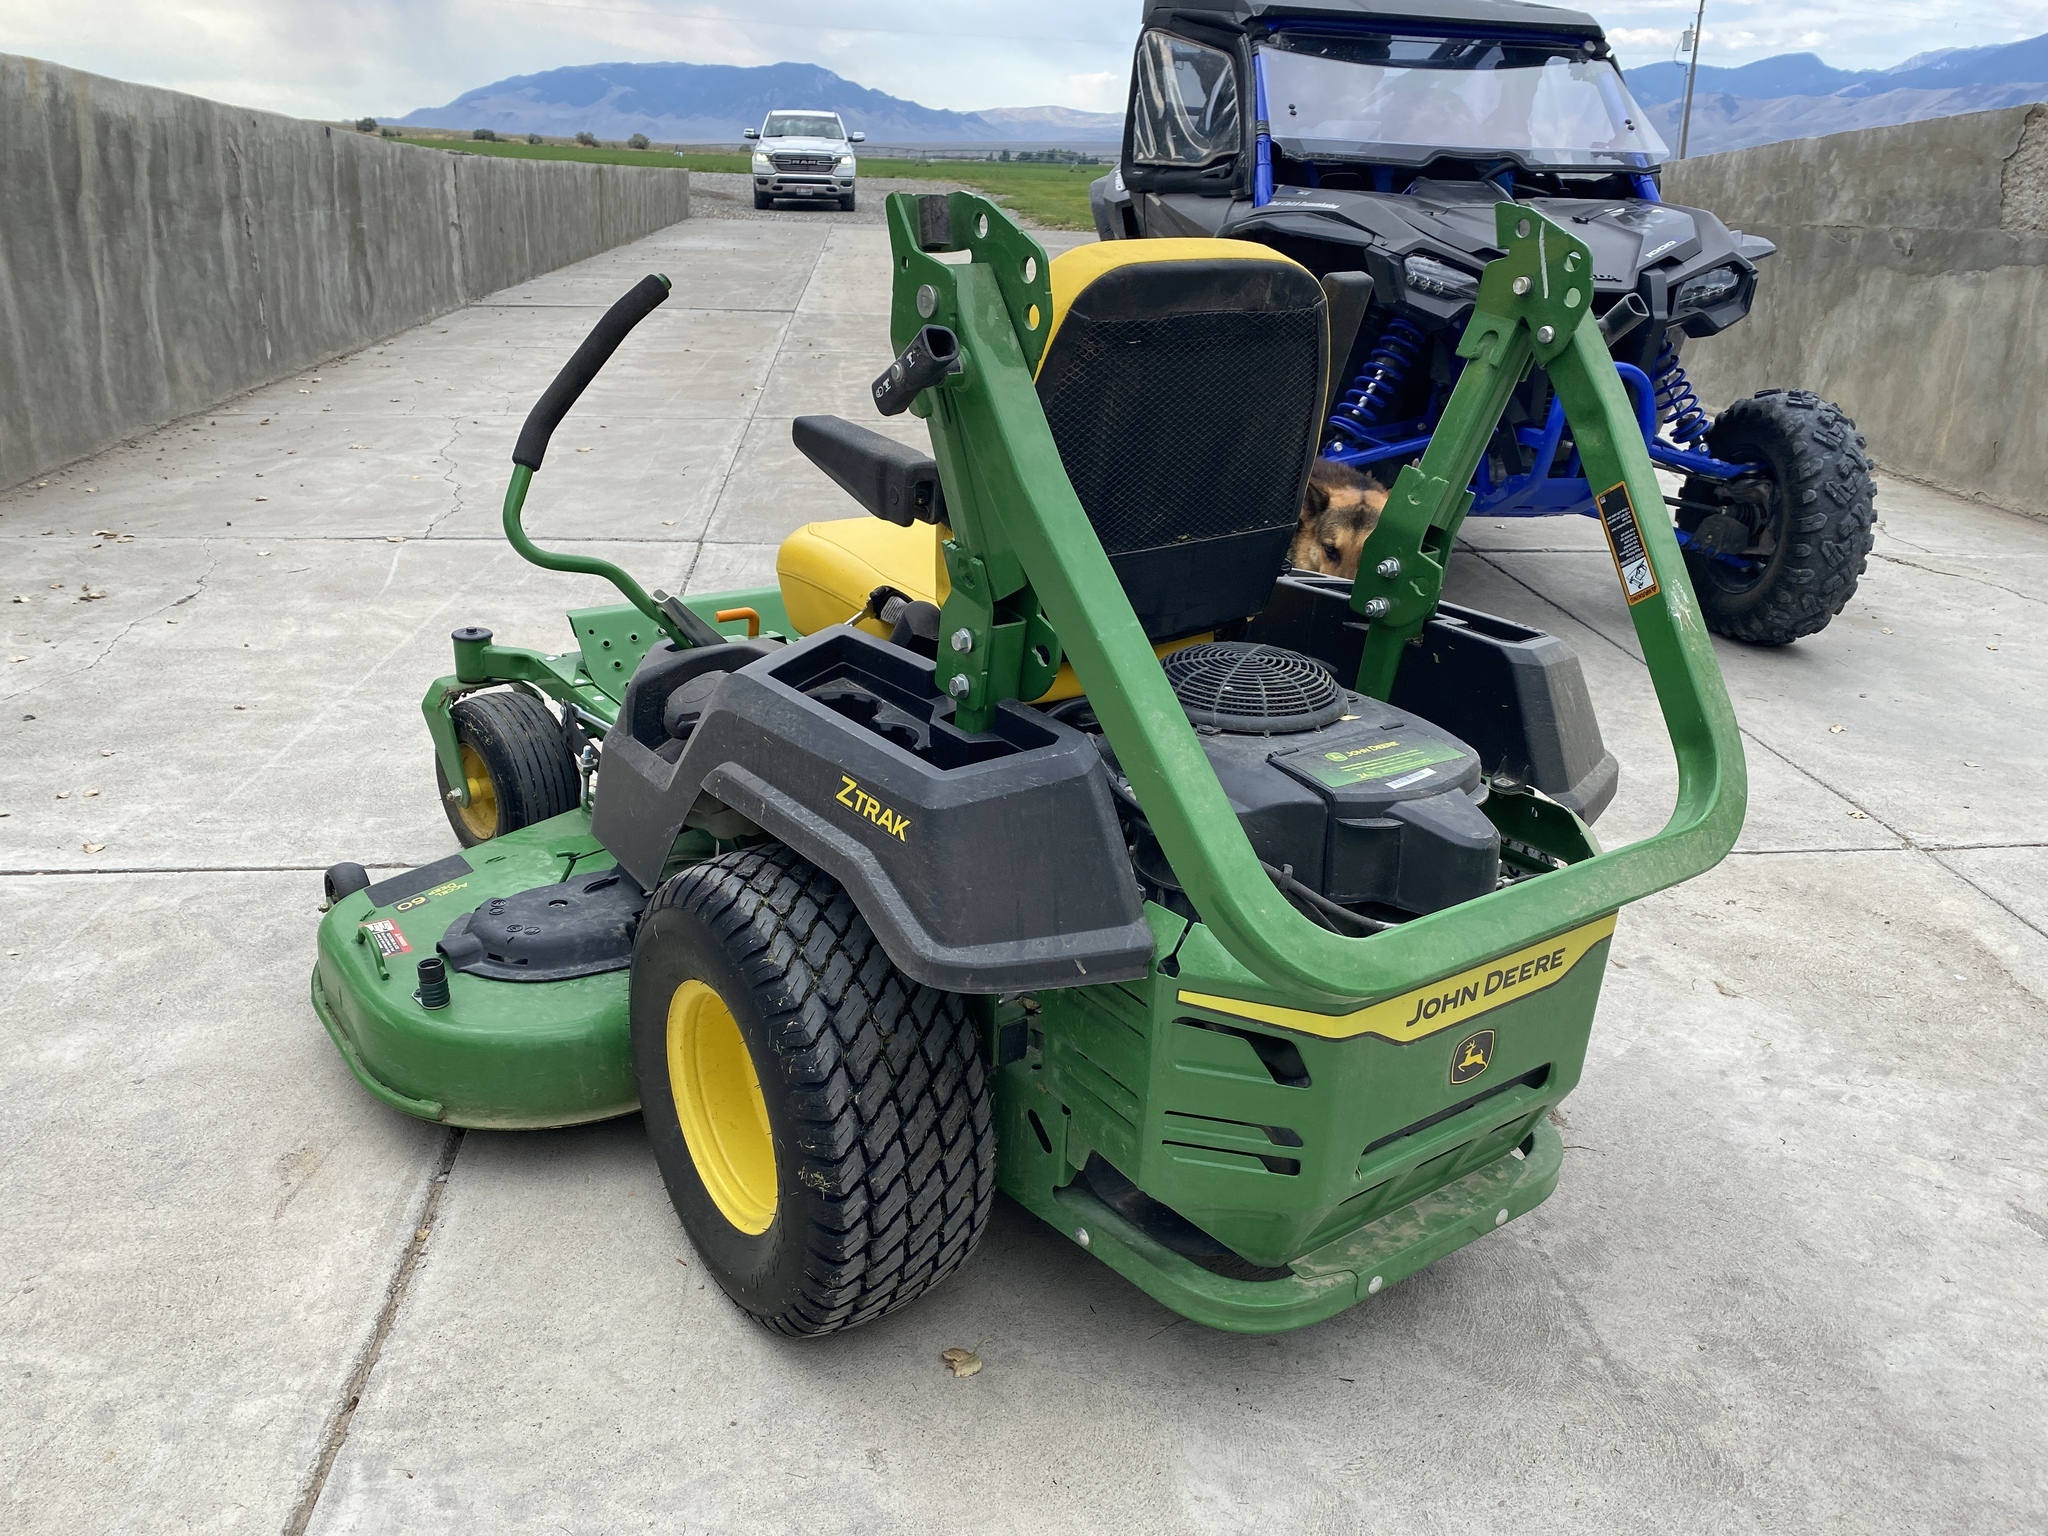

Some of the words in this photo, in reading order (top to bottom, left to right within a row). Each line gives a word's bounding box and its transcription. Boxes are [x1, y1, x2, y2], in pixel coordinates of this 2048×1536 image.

[1645, 240, 1677, 258] 1000
[1345, 745, 1371, 757] JOHN
[835, 774, 911, 842] ZTRAK
[396, 896, 426, 911] 60
[1405, 982, 1479, 1028] JOHN
[1483, 947, 1566, 997] DEERE
